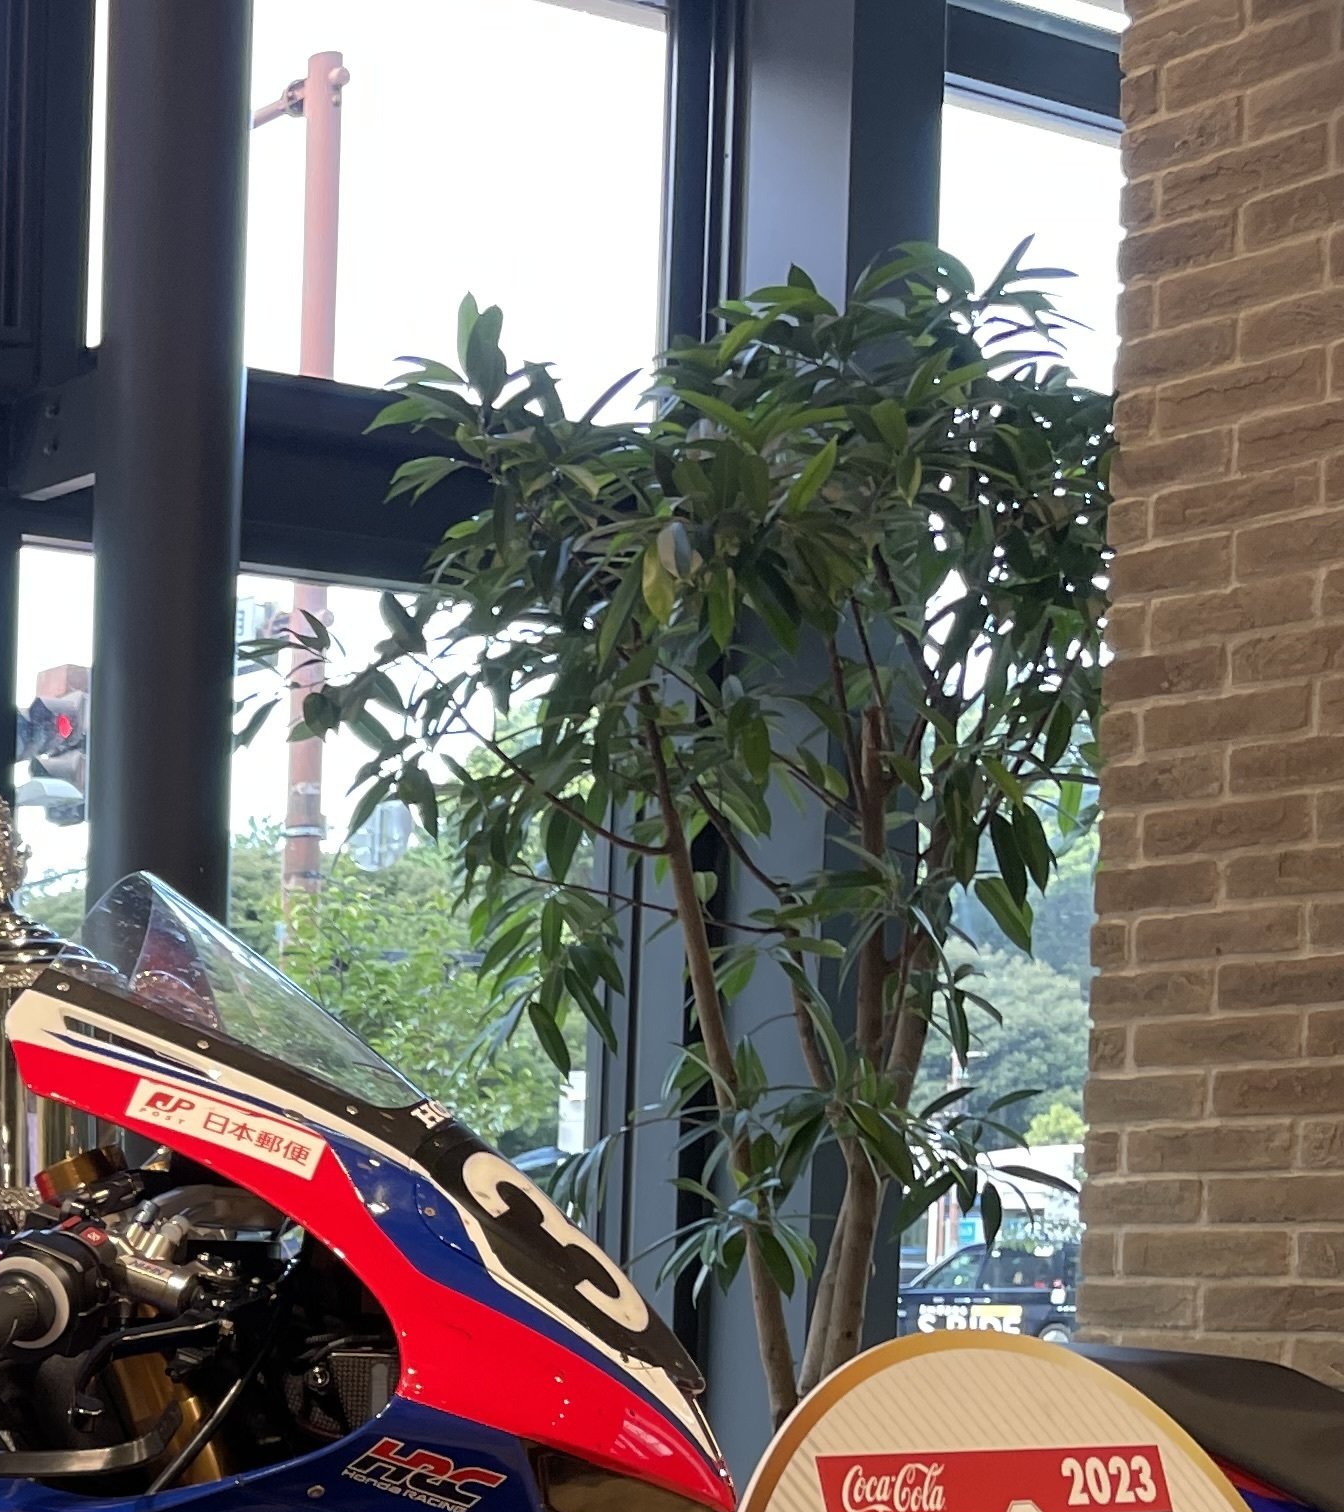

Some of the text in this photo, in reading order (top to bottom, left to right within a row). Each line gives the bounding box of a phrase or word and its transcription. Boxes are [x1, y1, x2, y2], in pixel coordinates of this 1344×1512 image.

[202, 1111, 312, 1167] 日本郵便
[346, 1436, 508, 1509] HRC
[1060, 1455, 1158, 1506] 2023
